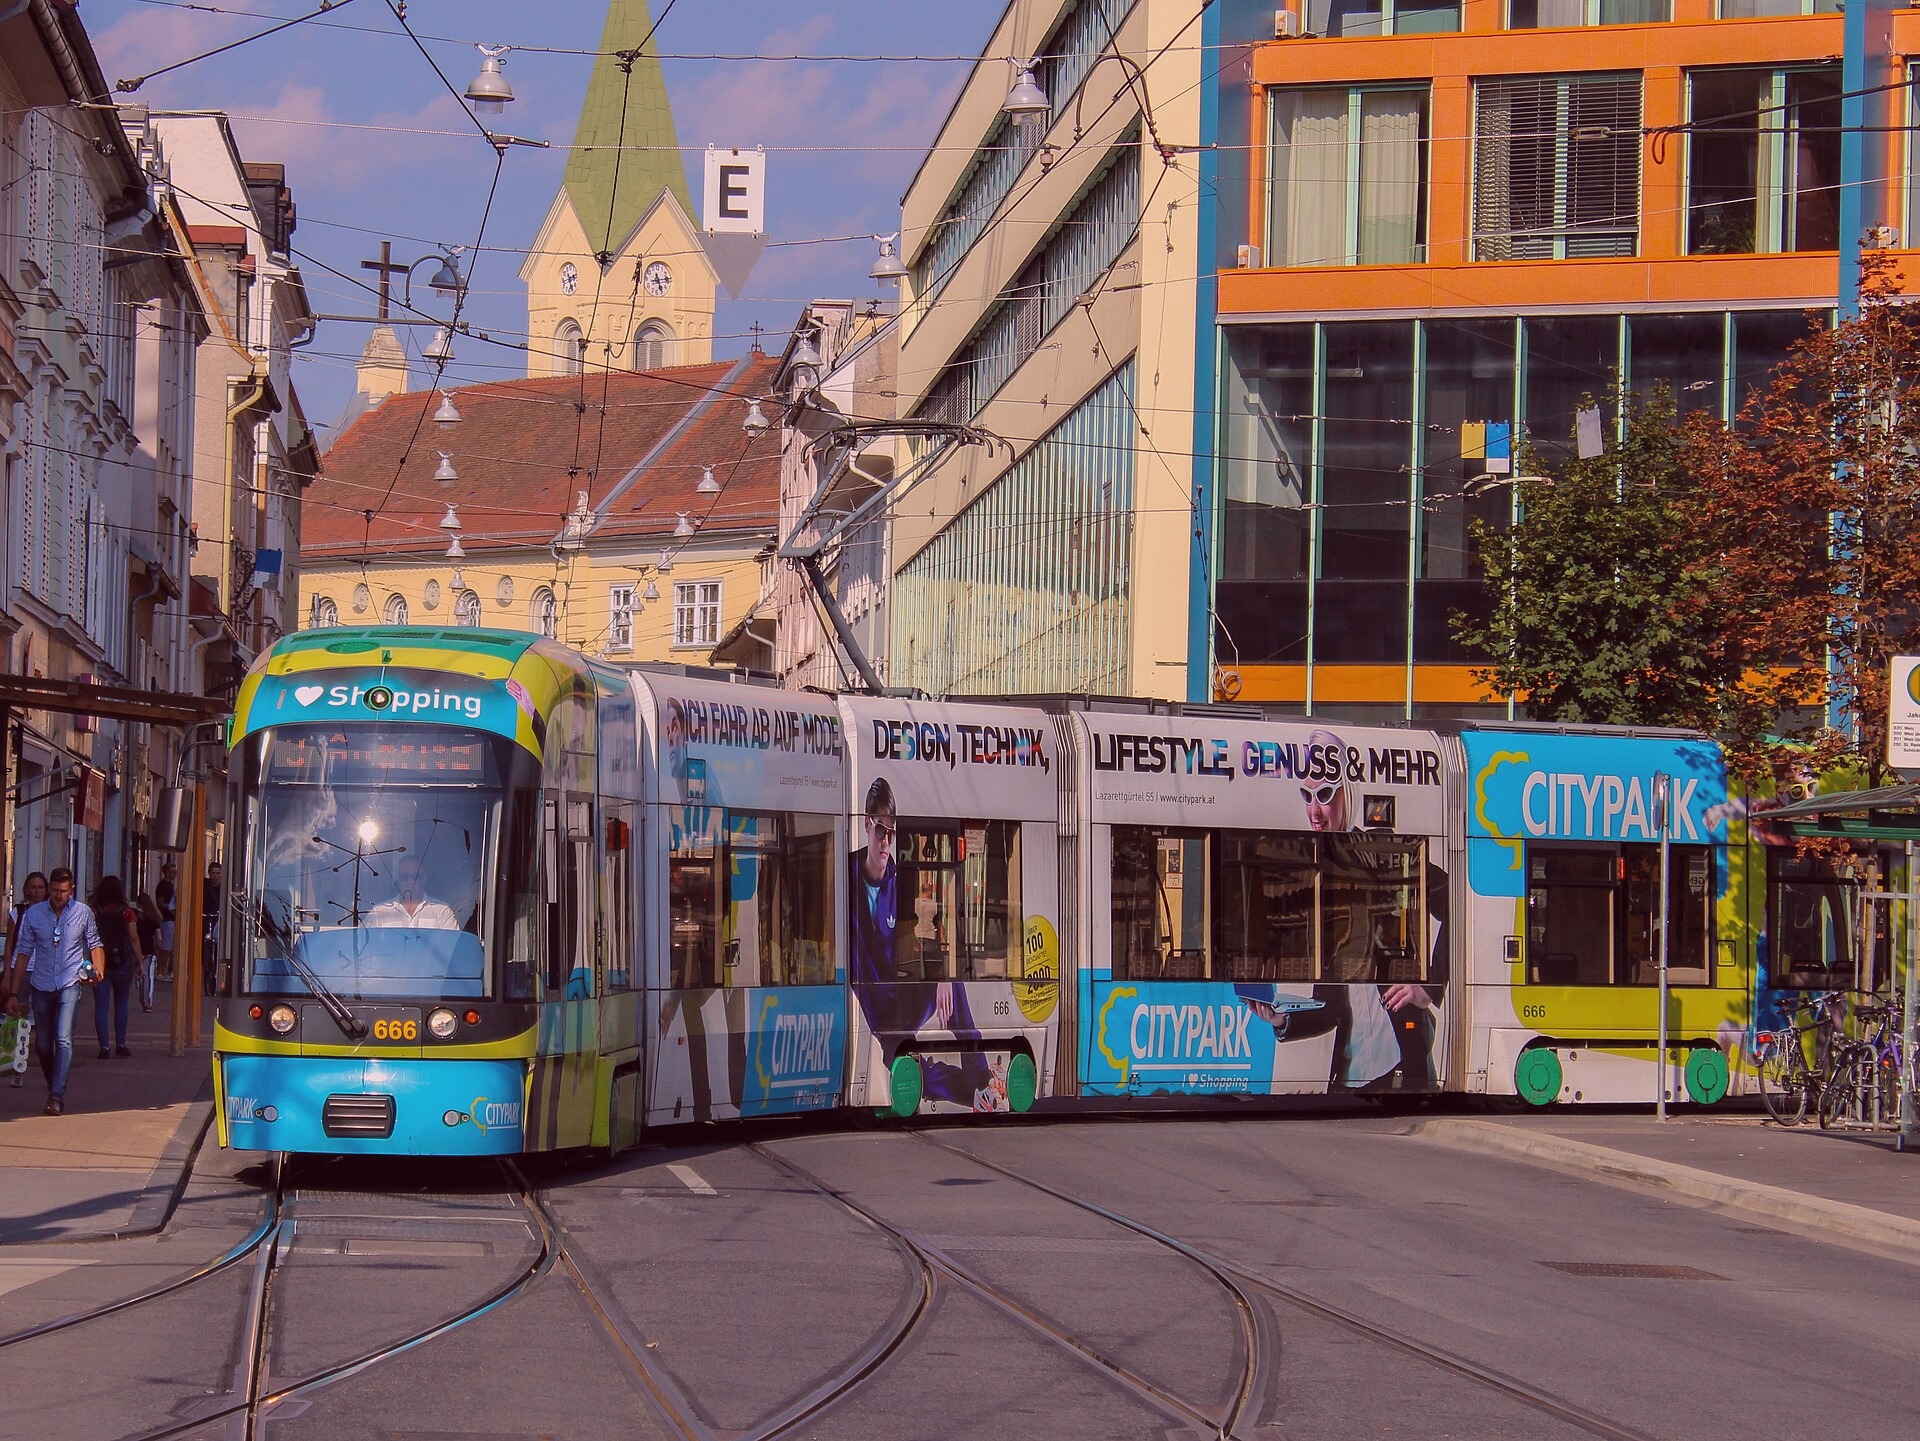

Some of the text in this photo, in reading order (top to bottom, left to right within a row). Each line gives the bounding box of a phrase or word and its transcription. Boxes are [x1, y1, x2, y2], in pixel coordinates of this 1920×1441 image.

[719, 165, 750, 219] E
[326, 686, 482, 719] Shpping
[682, 698, 842, 766] ICH FAHR AB AUF MODE,
[872, 720, 1050, 776] DESIGN, TECHNIK,
[1092, 732, 1442, 786] LIFESTYLE, GENUSS & MEHR
[1094, 790, 1216, 806] Lazarettgürtel 55 www.citypark.at
[1026, 931, 1044, 954] 100
[993, 1001, 1010, 1015] 666
[1523, 1005, 1546, 1018] 666
[374, 1019, 417, 1040] 666
[771, 1012, 835, 1076] CITYPARK
[1130, 1002, 1253, 1060] CITYPARK
[1199, 1073, 1249, 1091] Shopping
[485, 1101, 521, 1126] CITYPARK
